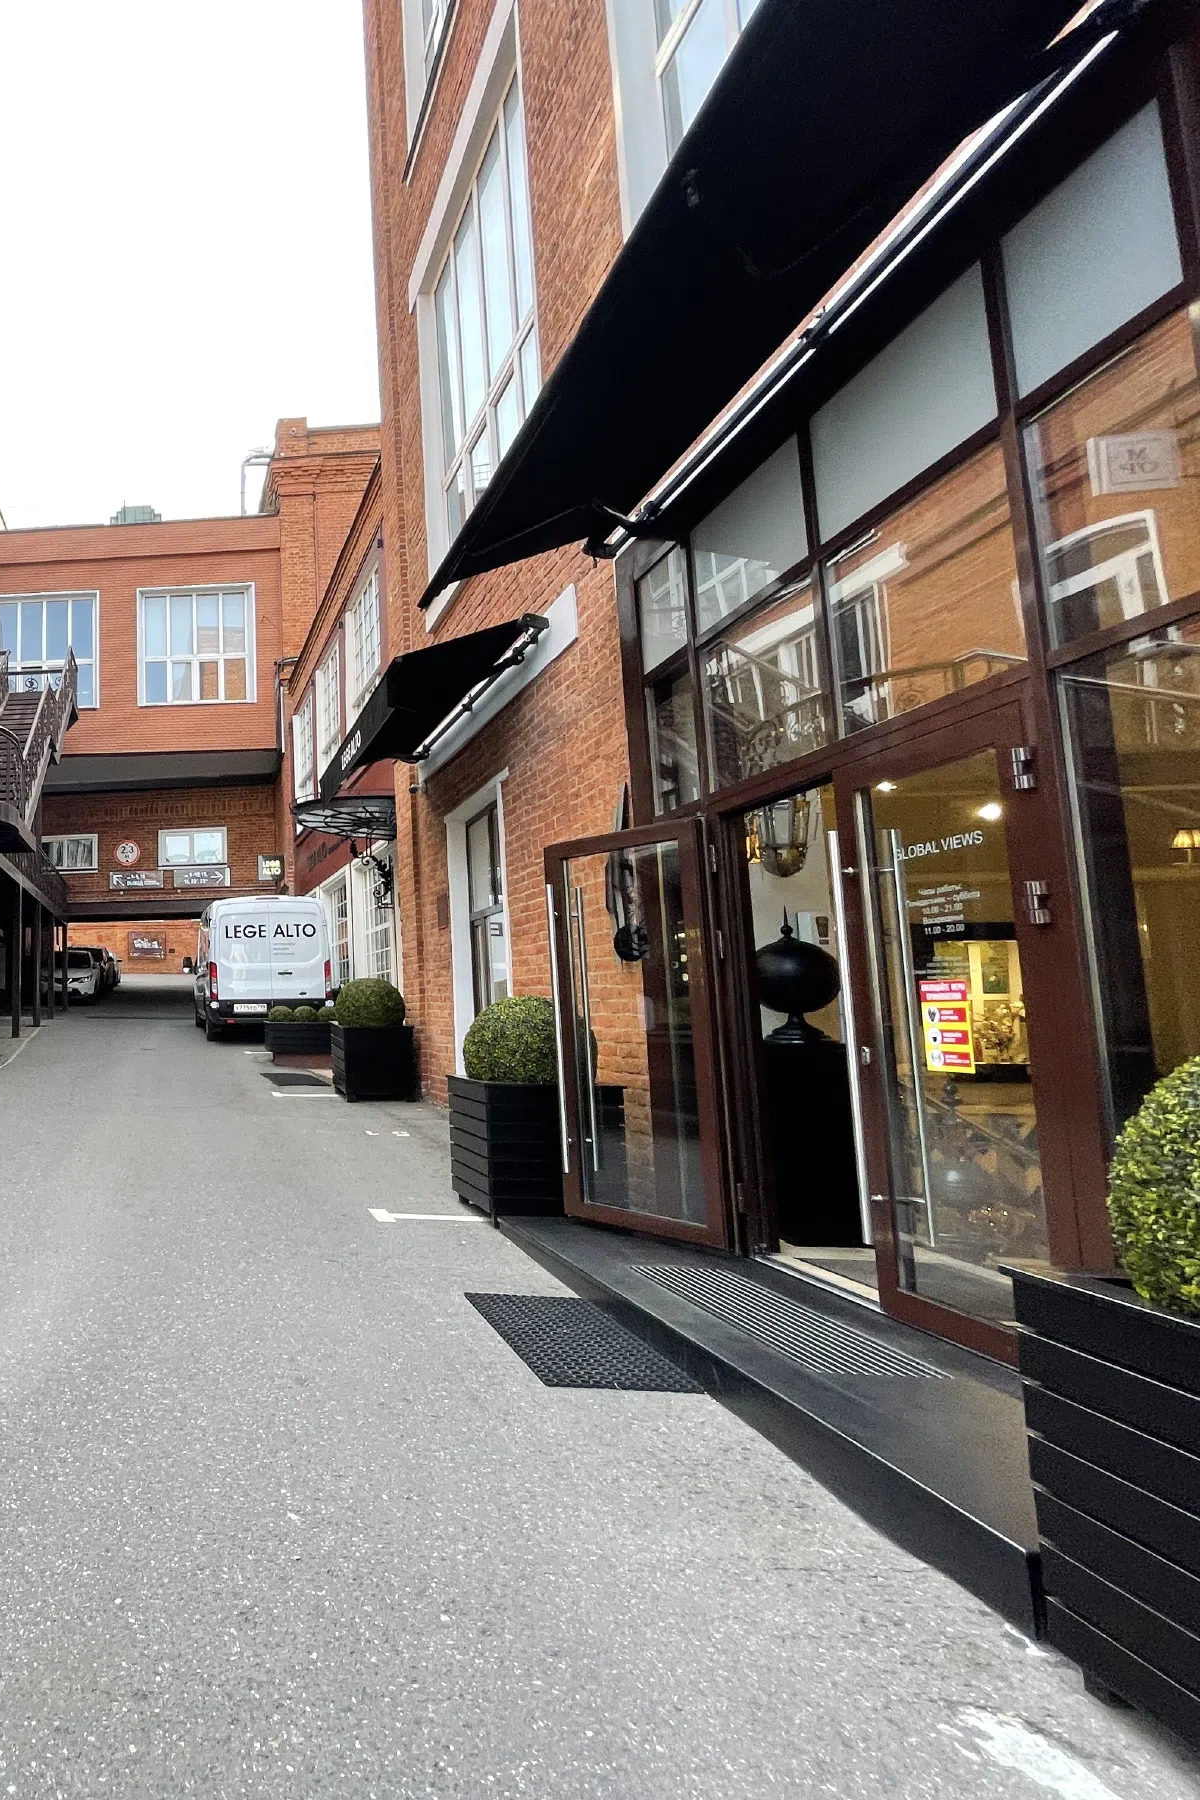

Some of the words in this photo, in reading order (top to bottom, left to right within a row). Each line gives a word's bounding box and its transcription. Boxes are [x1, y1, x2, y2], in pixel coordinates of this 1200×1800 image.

[895, 841, 940, 861] GLOBAL
[941, 830, 984, 851] VIEWS
[262, 867, 281, 876] ALTO
[225, 924, 267, 939] LEGE
[272, 923, 317, 938] ALTO
